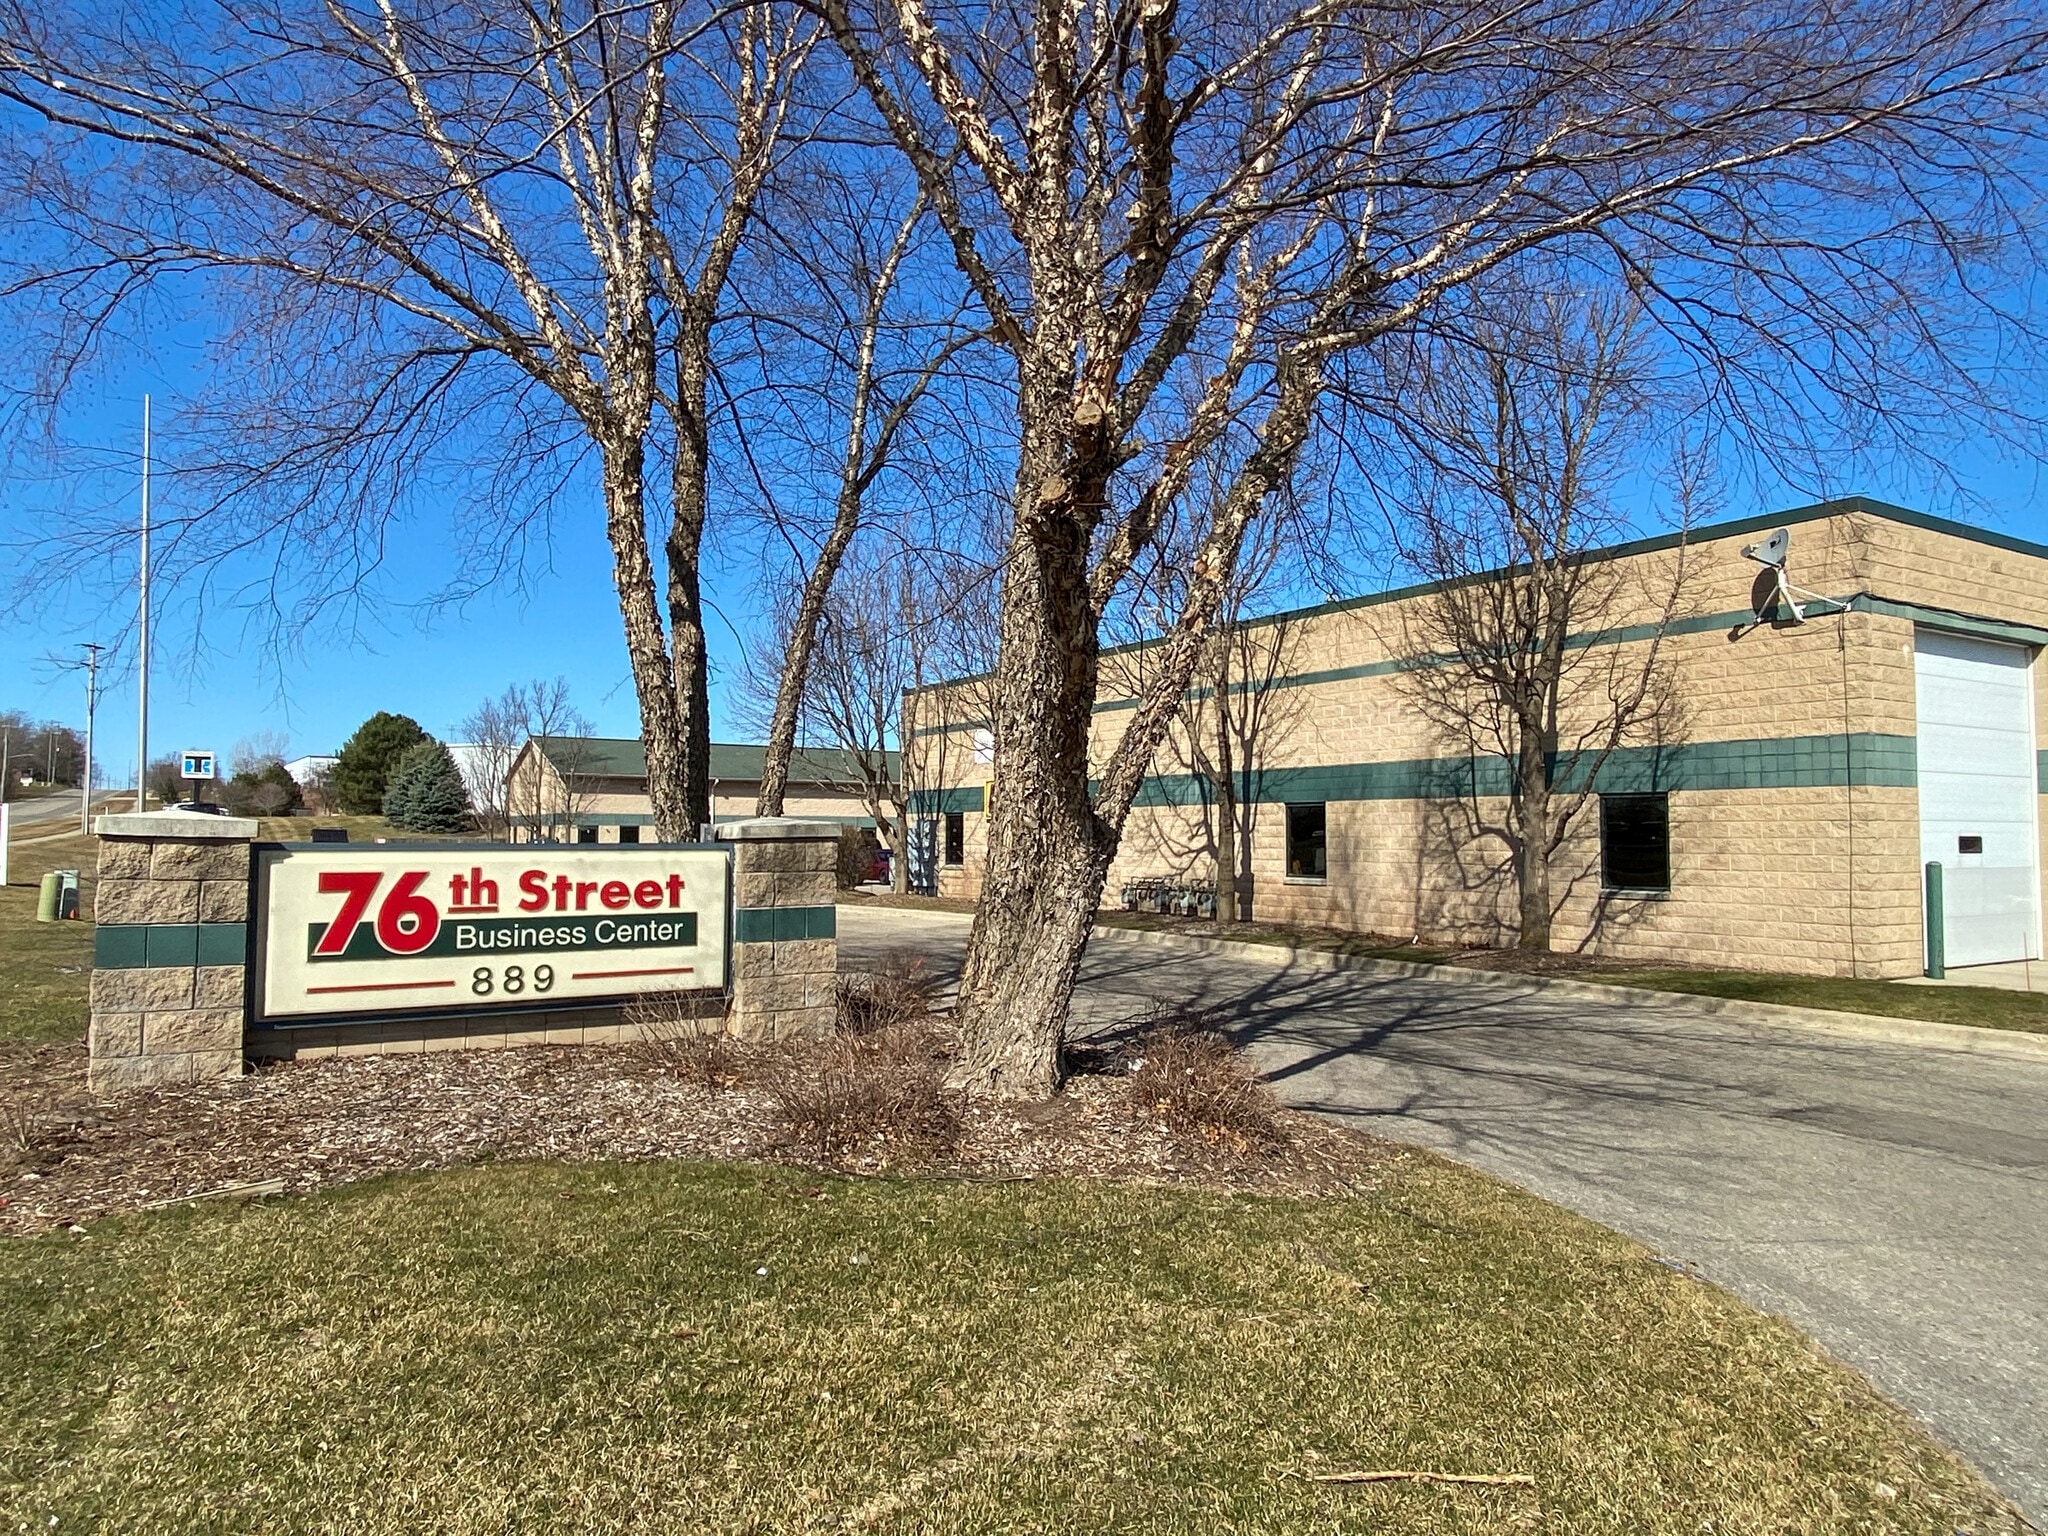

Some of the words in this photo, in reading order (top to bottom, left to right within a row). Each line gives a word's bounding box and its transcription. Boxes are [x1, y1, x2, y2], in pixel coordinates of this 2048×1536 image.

[518, 869, 685, 912] Street
[456, 924, 586, 949] Business
[595, 920, 684, 943] Center
[471, 964, 554, 996] 889
